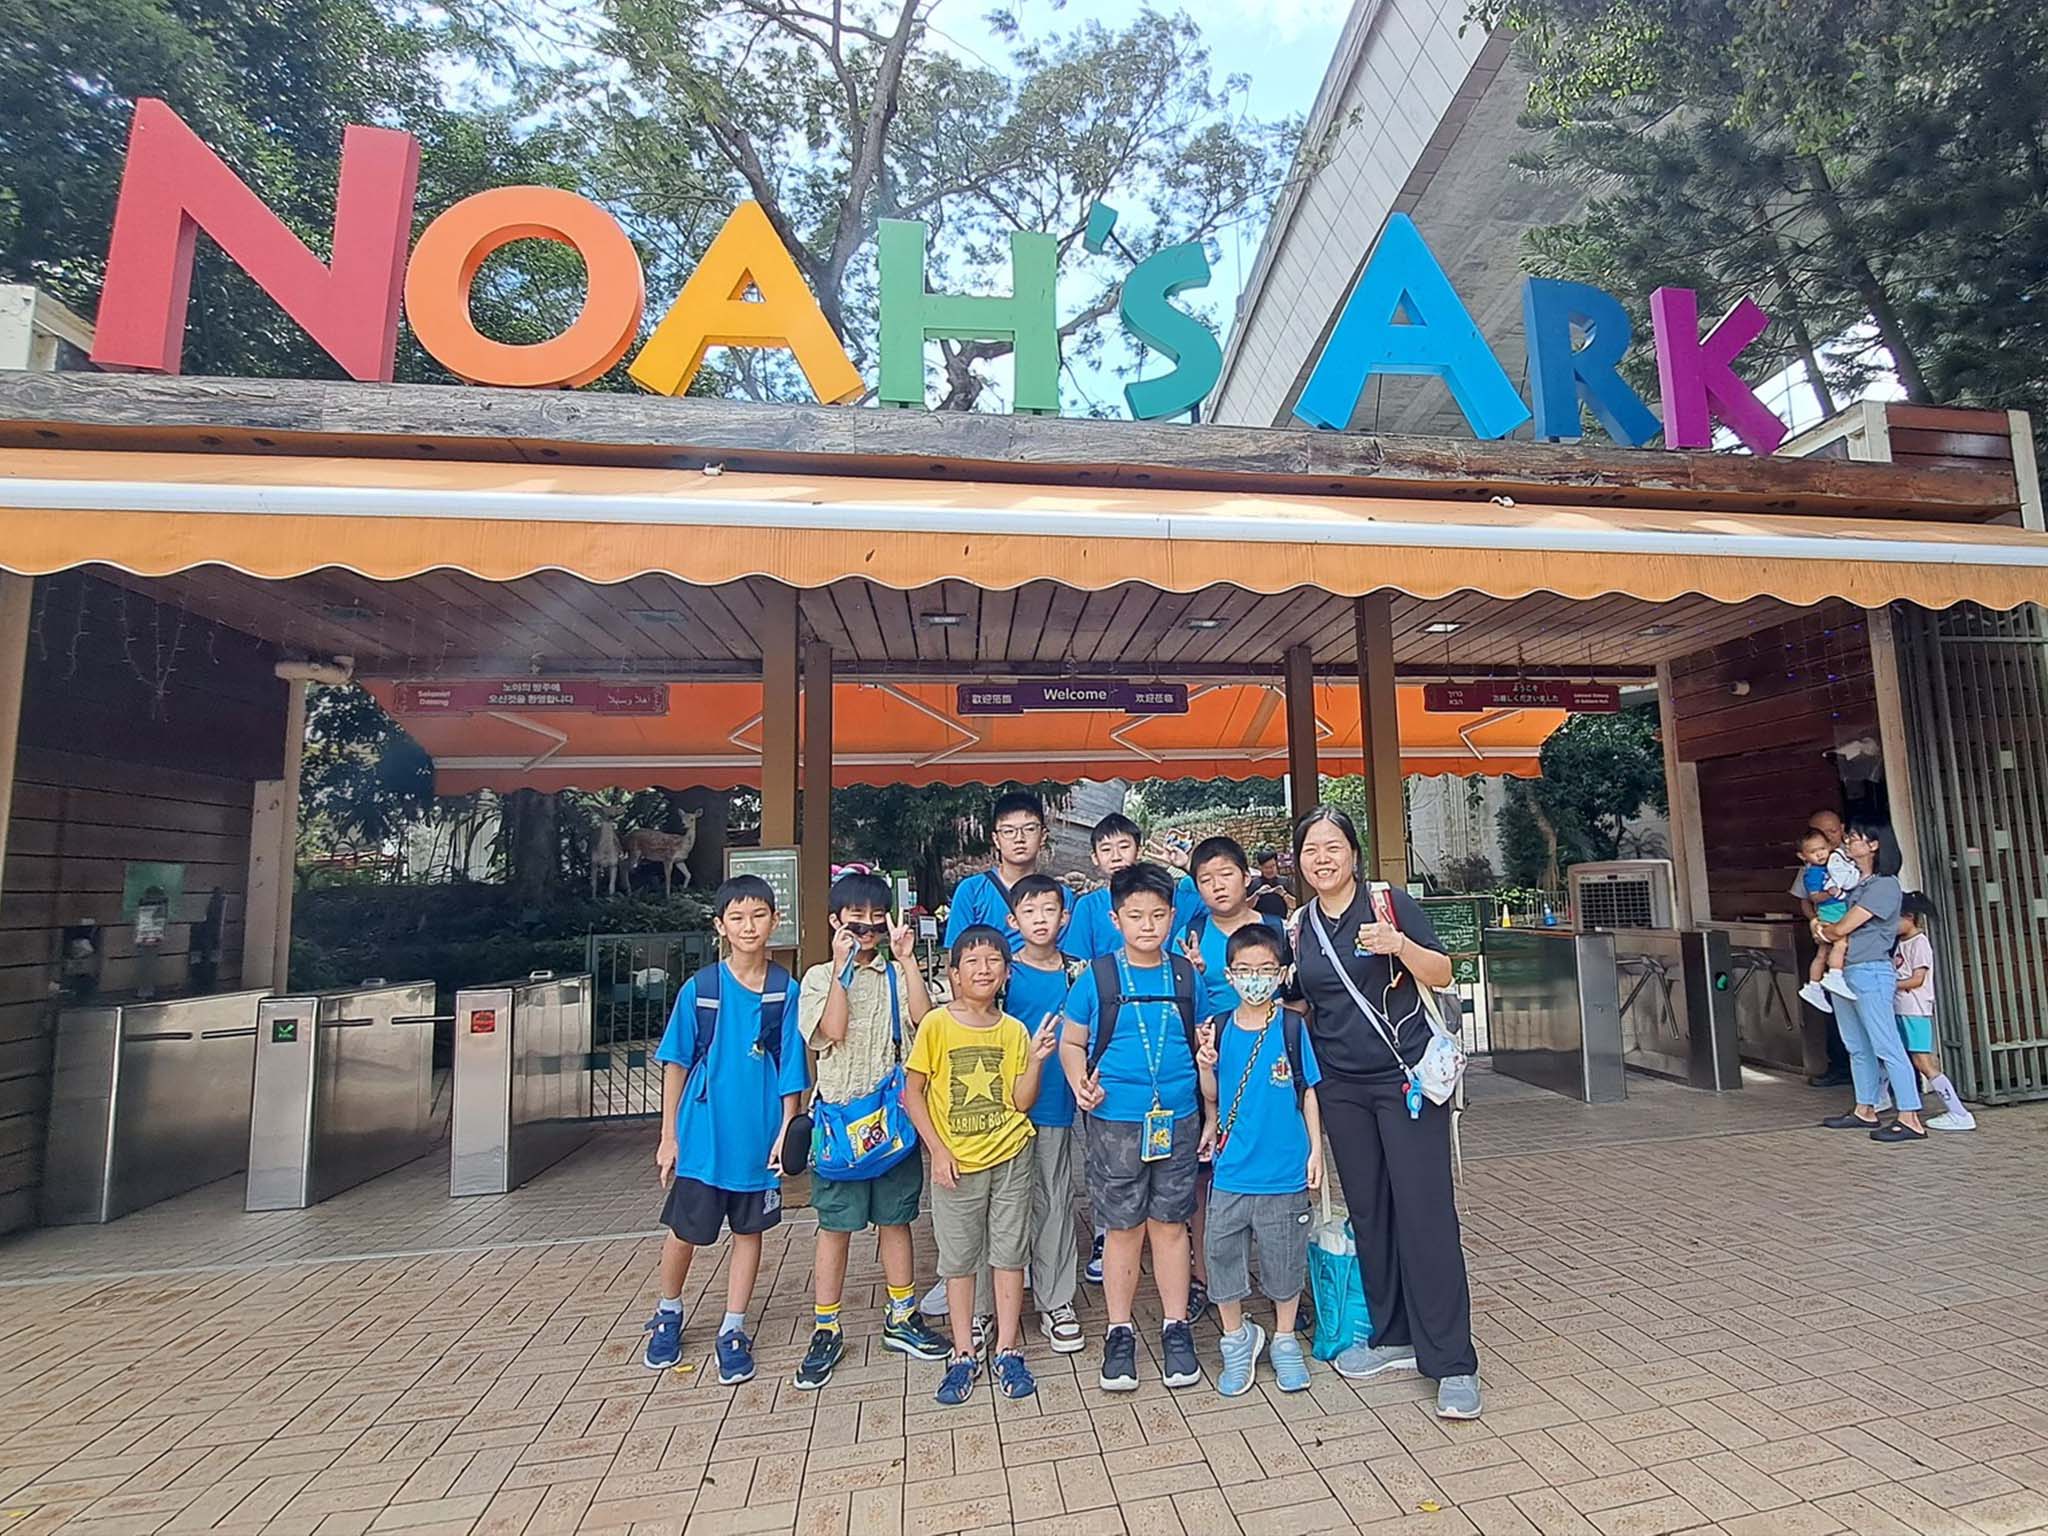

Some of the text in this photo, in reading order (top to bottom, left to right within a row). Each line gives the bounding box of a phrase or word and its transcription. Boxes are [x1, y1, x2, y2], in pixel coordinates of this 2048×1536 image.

[89, 97, 1790, 458] NOAH'S ARK
[1043, 687, 1108, 701] Welcome
